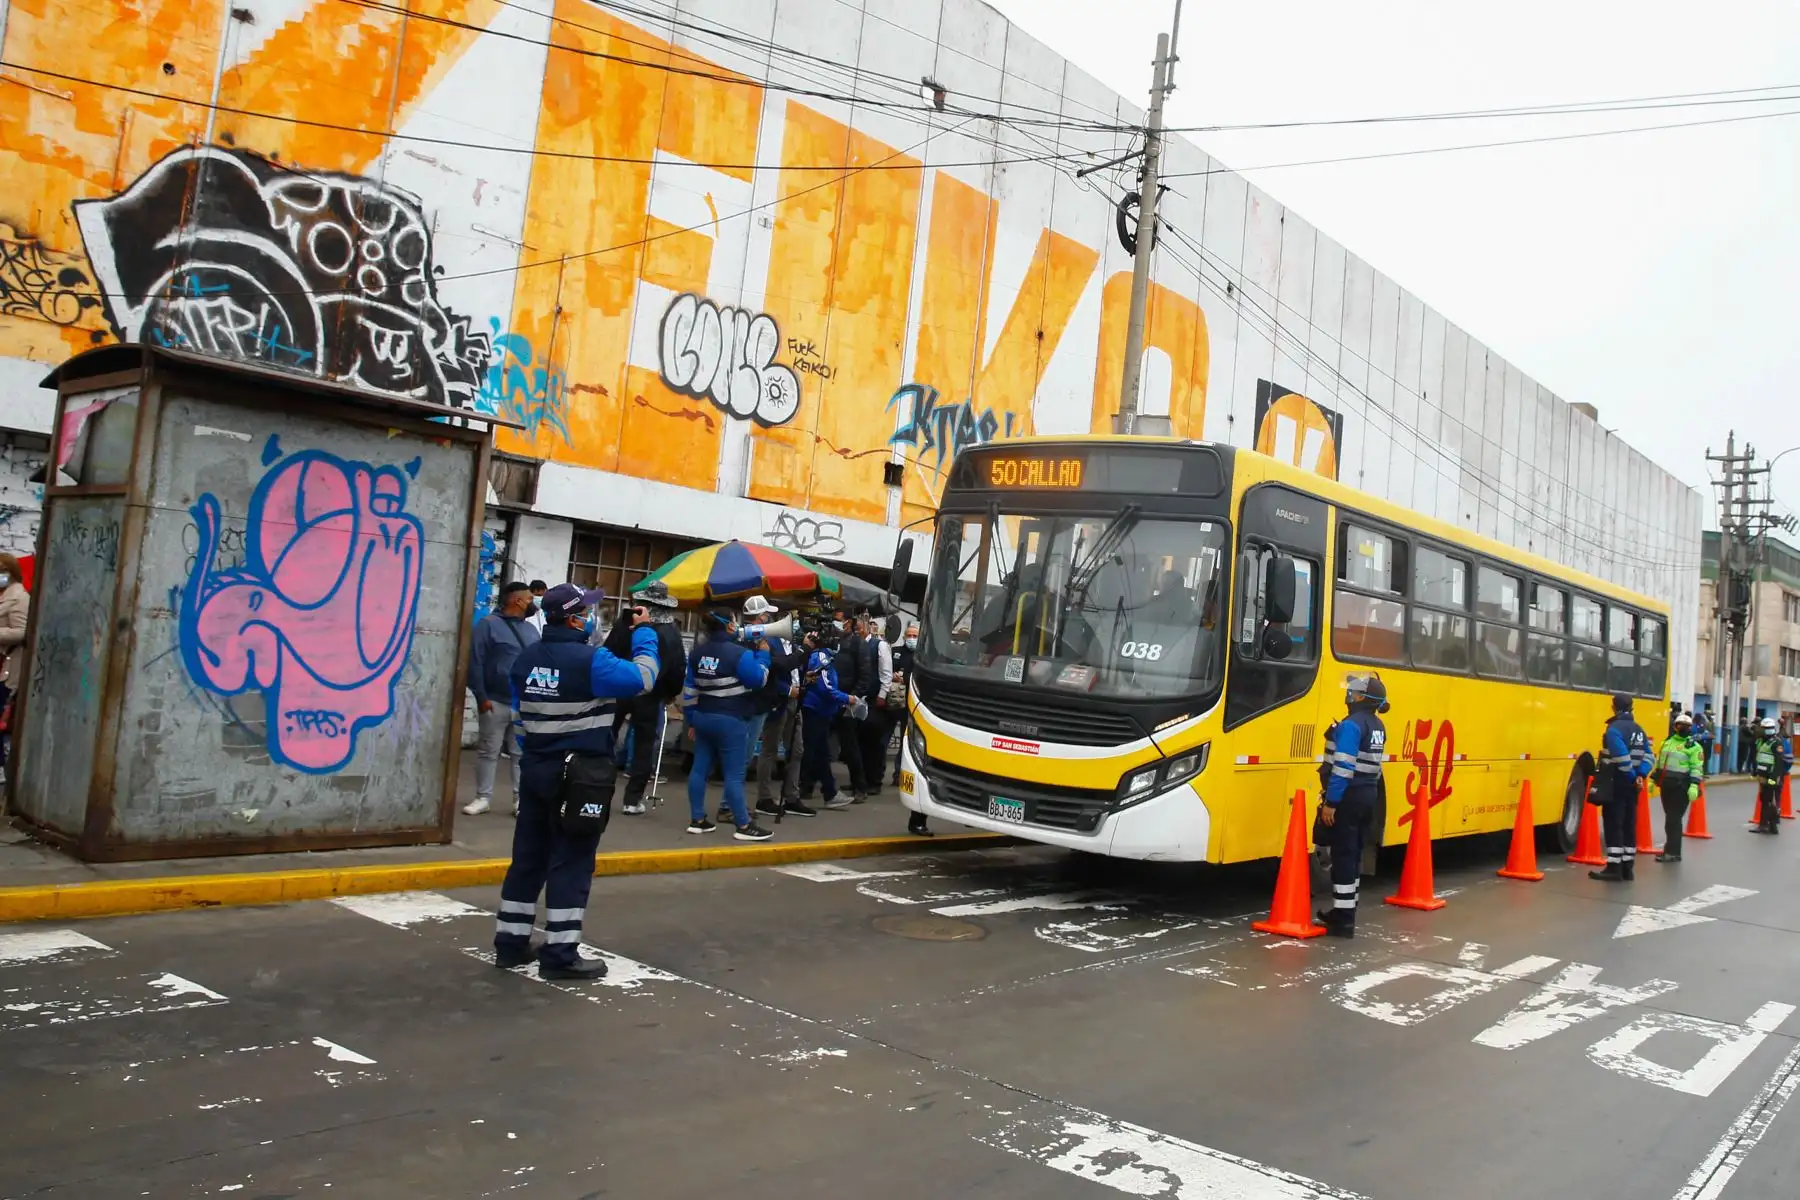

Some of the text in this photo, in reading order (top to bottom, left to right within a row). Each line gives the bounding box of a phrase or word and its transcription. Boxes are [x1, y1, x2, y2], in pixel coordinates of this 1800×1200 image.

[991, 460, 1081, 487] 50 CALLAO
[1121, 641, 1163, 661] 038
[698, 655, 720, 671] ATU
[525, 666, 560, 689] ATU
[1405, 718, 1455, 807] 50
[580, 803, 603, 814] ATU
[989, 802, 1022, 821] BBJ-865
